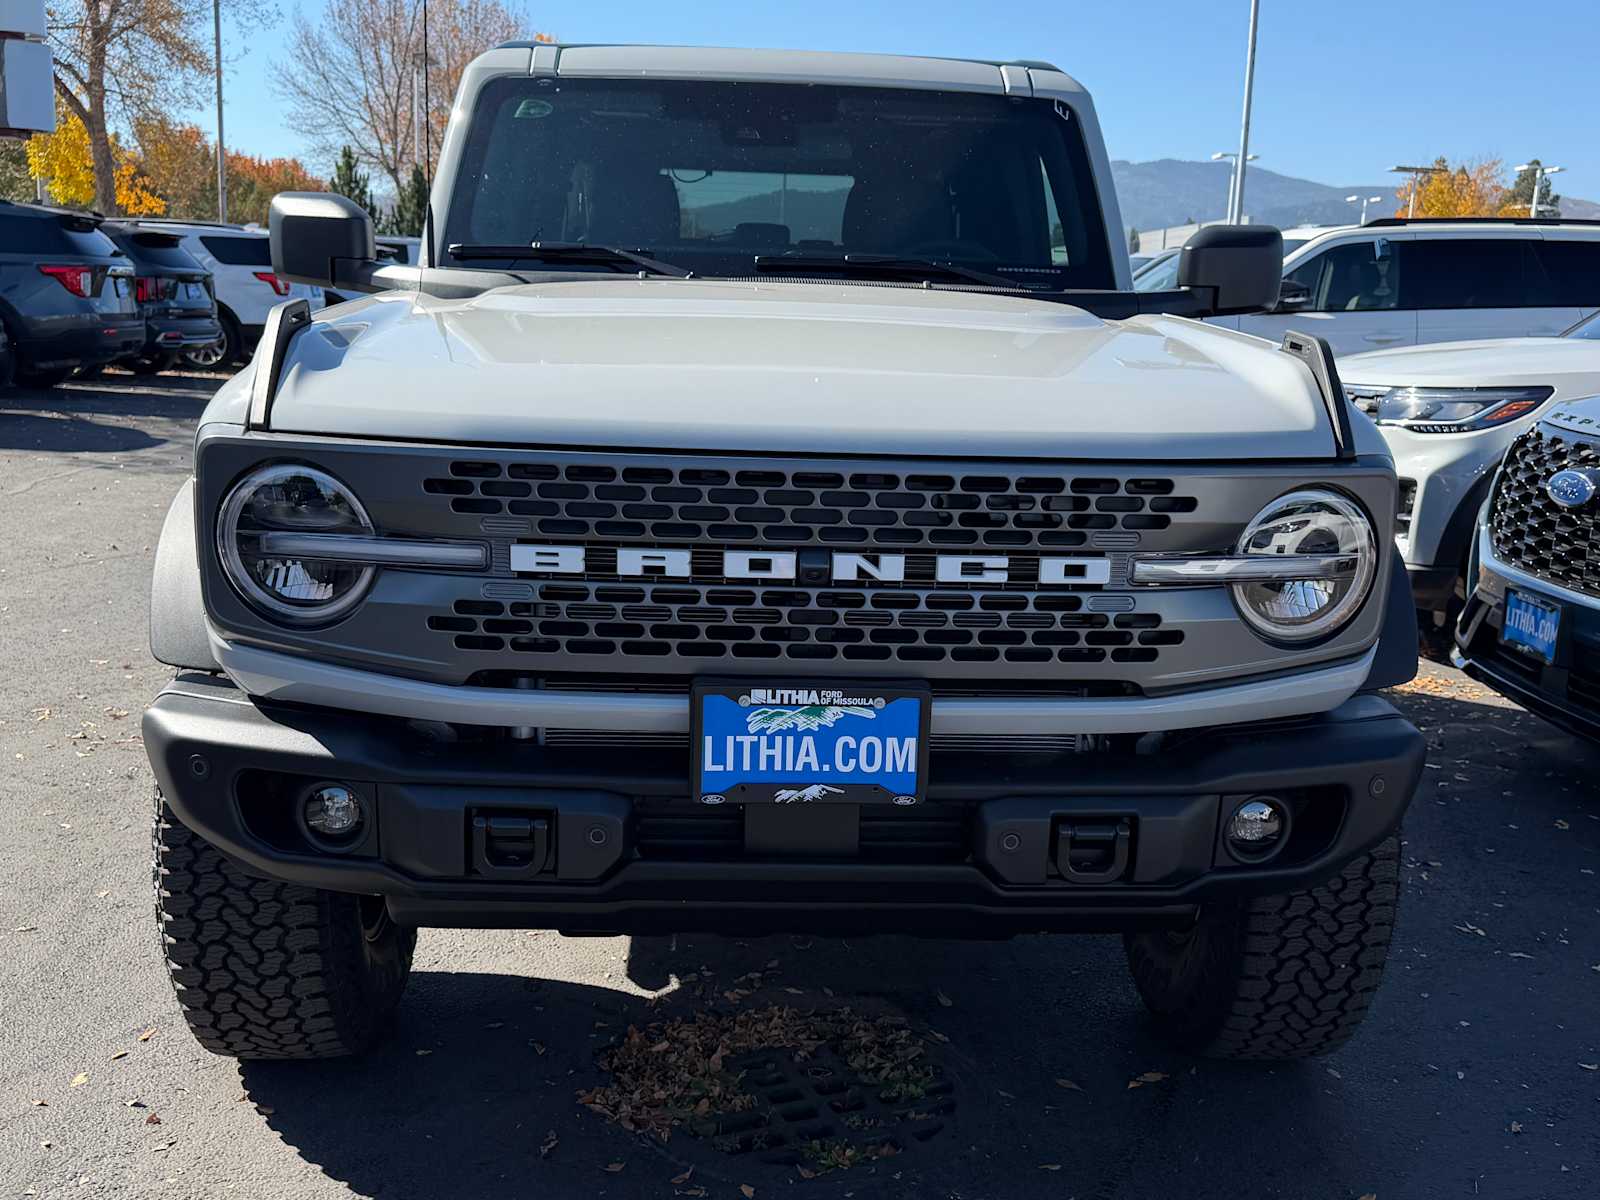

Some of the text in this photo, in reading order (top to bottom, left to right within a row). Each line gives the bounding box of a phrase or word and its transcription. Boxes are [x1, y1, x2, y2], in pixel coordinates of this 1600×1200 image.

[510, 543, 1111, 585] BRONCO
[766, 689, 820, 705] LITHIA
[821, 690, 842, 698] FORD
[821, 697, 874, 706] OF MISSOULA
[704, 735, 917, 773] LITHIA.COM
